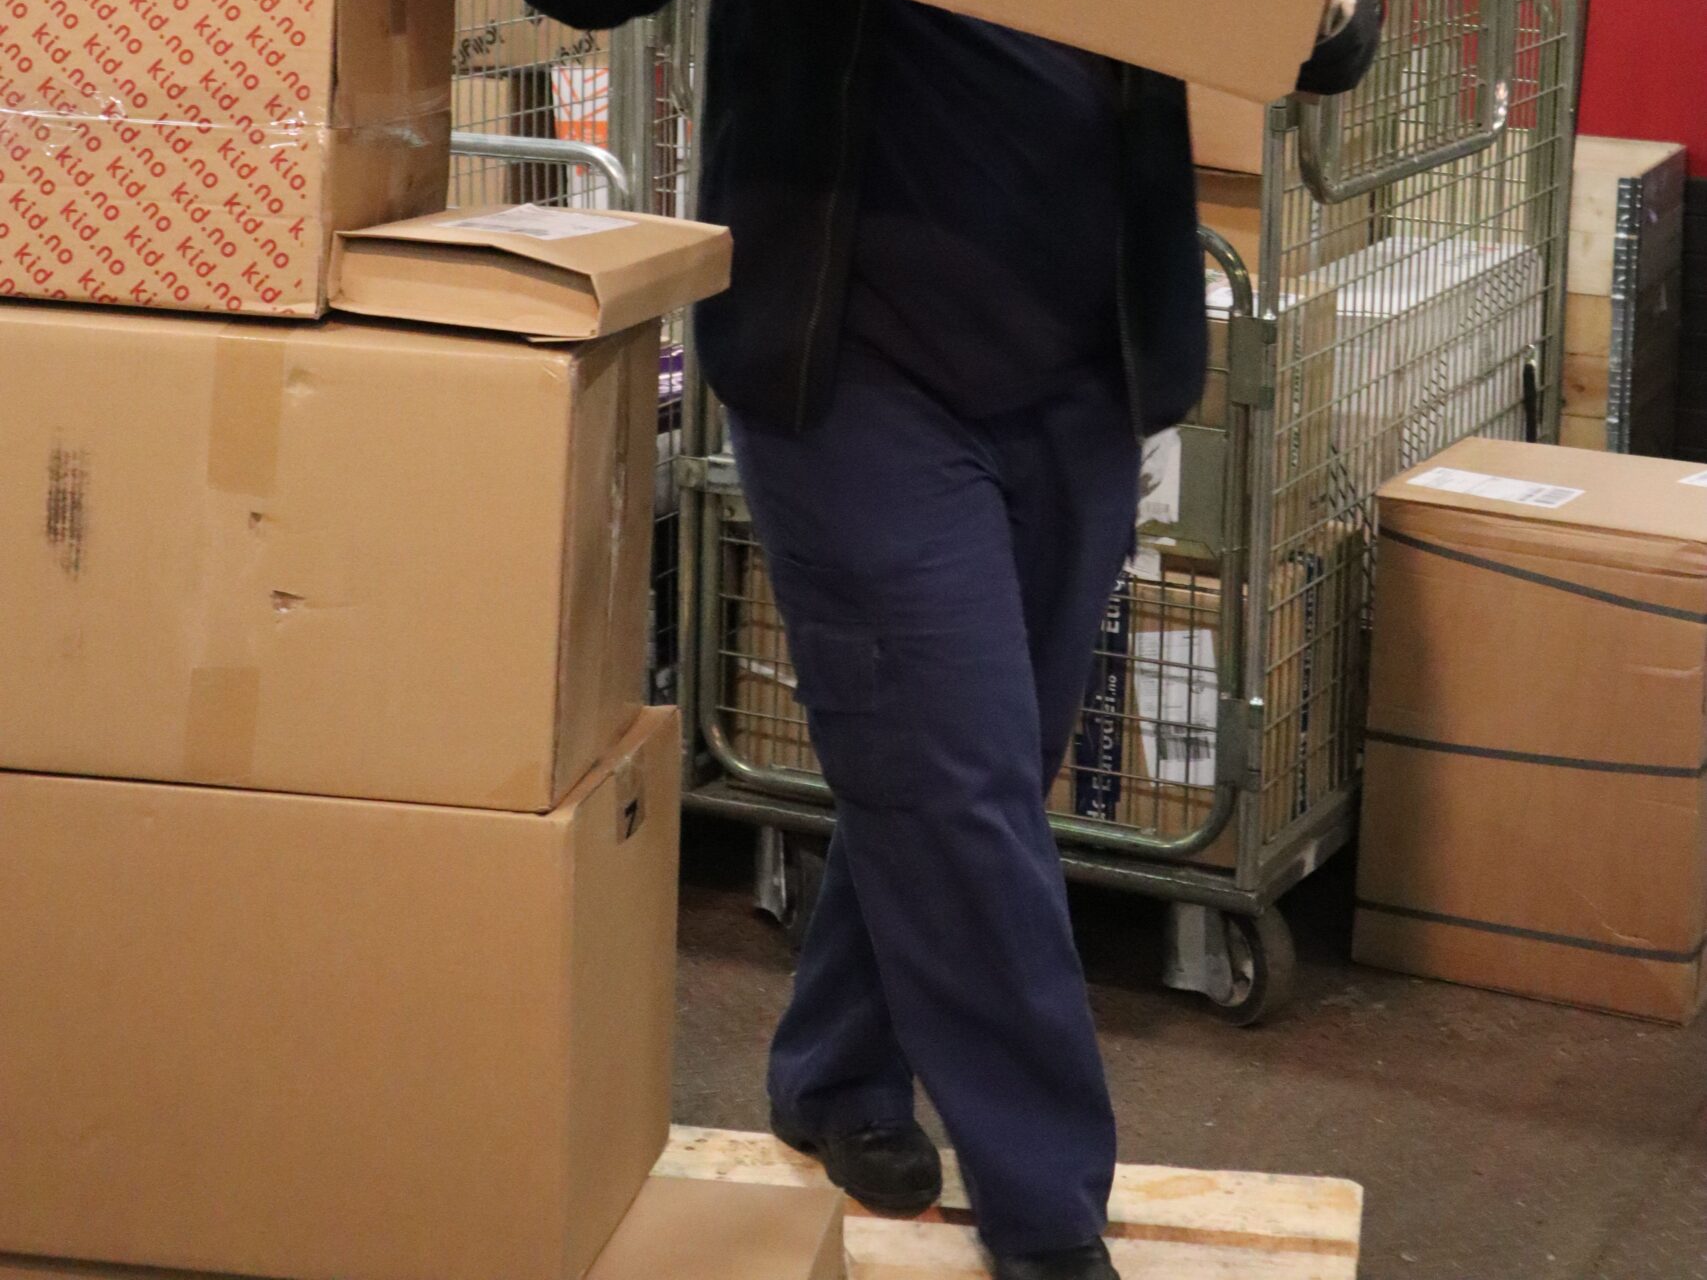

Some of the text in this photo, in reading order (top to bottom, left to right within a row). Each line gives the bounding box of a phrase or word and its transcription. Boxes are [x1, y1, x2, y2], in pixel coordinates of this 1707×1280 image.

[195, 14, 259, 90] kid.no
[200, 69, 264, 145] kid.no
[247, 25, 311, 101] kid.no
[32, 22, 96, 98] kid.no
[172, 182, 236, 258] kid.no
[84, 33, 148, 109] kid.no
[224, 193, 288, 269] kid.no
[148, 58, 212, 134] kid.no
[219, 138, 283, 214] kid.no
[9, 189, 73, 265] kid.no
[56, 145, 120, 221] kid.no
[125, 225, 189, 301] kid.no
[61, 199, 125, 275] kid.no
[107, 156, 171, 232] kid.no
[178, 236, 242, 312] kid.no
